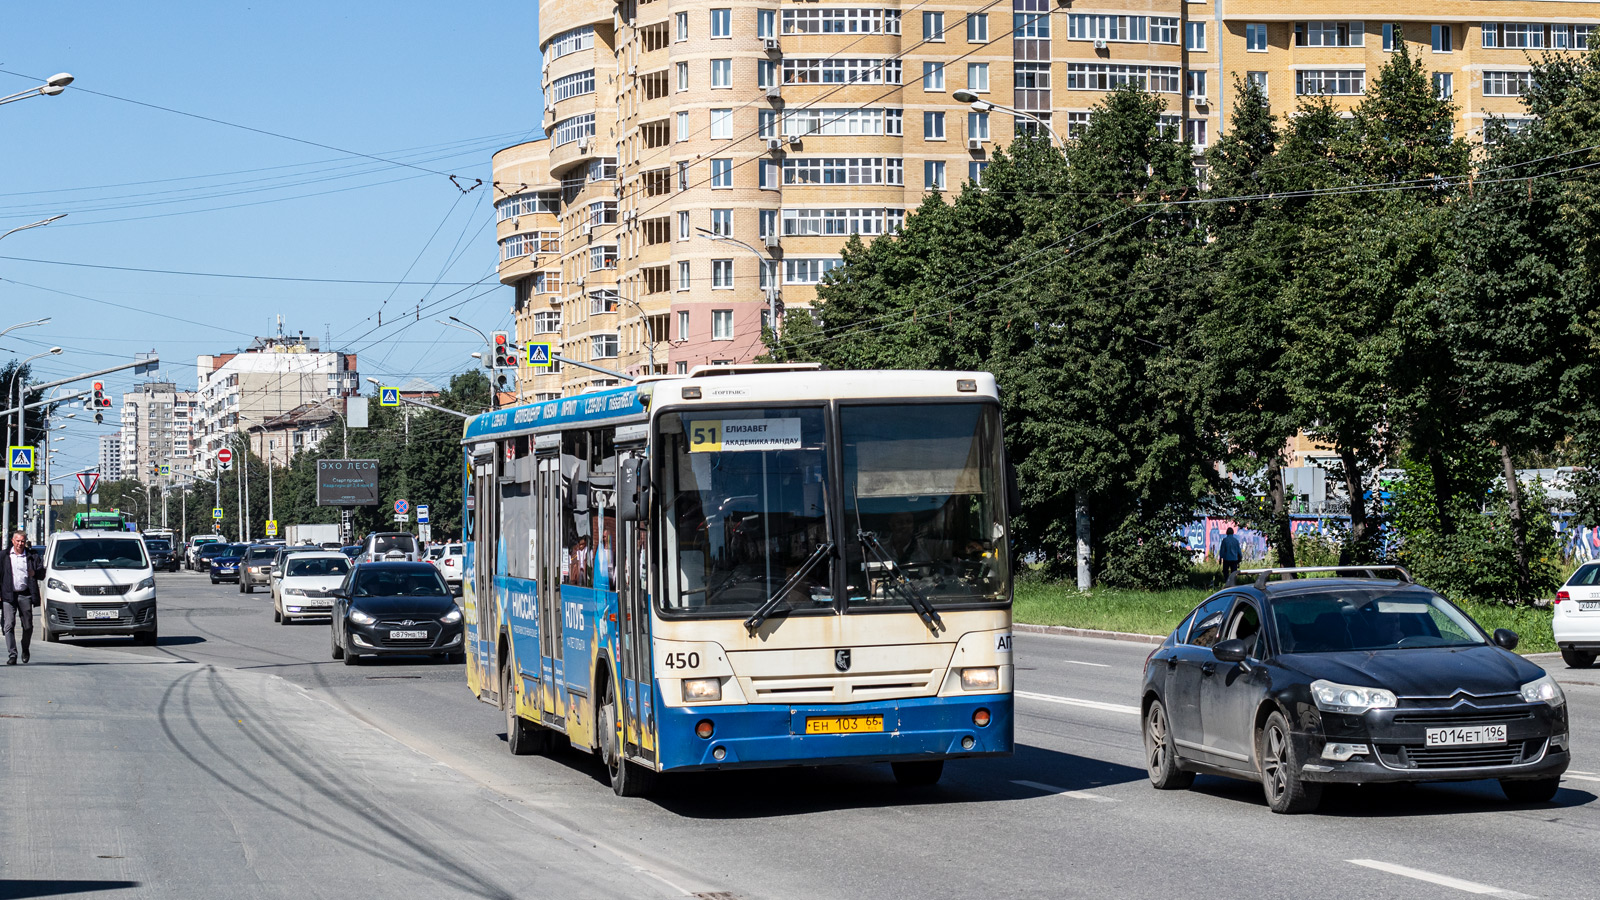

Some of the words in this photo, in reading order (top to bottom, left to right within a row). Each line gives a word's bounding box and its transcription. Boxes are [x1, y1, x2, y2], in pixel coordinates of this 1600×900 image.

[693, 427, 718, 445] 51
[725, 424, 768, 433] ЕЛИЗАВЕТ
[725, 438, 769, 446] АКАДЕМИКА
[769, 437, 799, 445] ЛАНДАУ
[321, 462, 342, 470] ЭХО
[347, 462, 376, 470] ЛЕСА
[565, 601, 585, 631] КЛУБ
[665, 651, 700, 669] 450
[813, 721, 829, 732] ЕН
[835, 717, 858, 731] 103
[865, 716, 879, 726] 66
[1431, 729, 1482, 744] Е014ЕТ
[1484, 726, 1504, 738] 196
